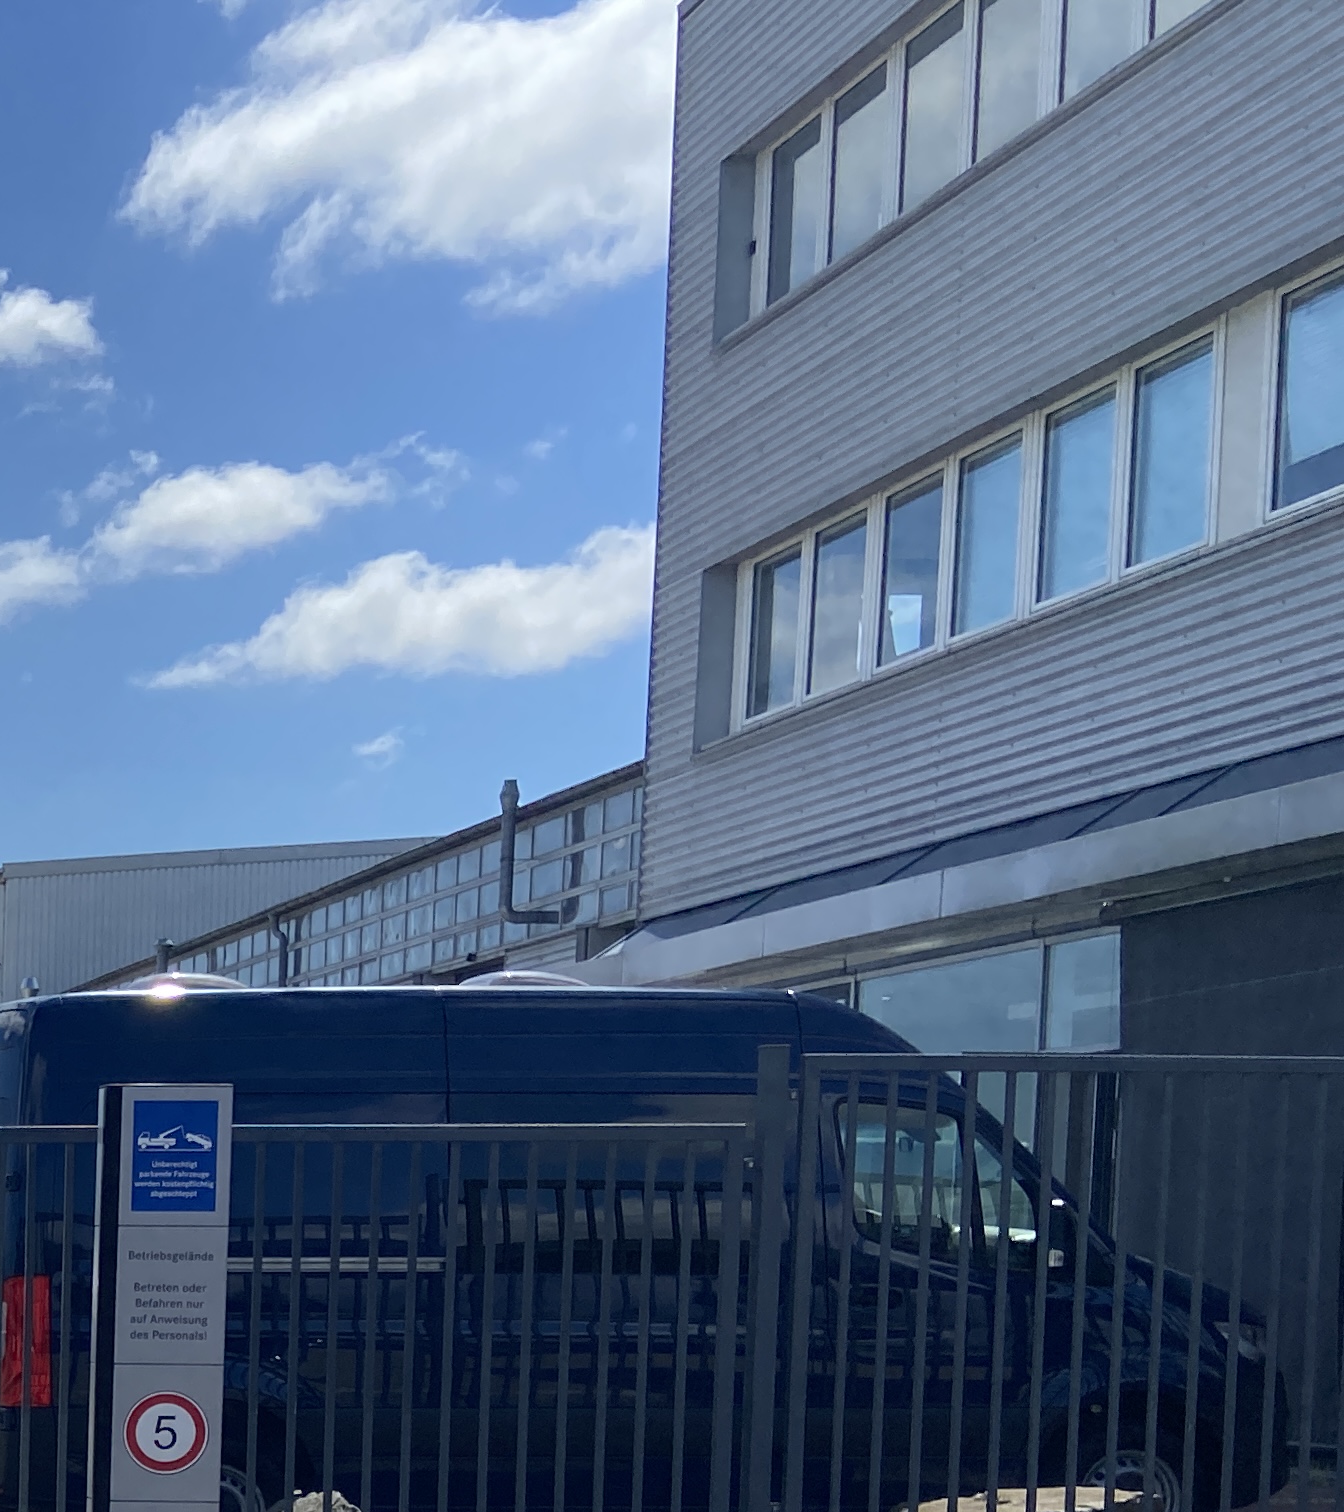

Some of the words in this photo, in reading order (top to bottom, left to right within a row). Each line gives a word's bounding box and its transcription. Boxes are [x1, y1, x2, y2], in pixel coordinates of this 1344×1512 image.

[173, 1171, 210, 1180] Fahrzeuge
[128, 1250, 214, 1263] Betriebsgelände
[133, 1282, 180, 1293] Betreten
[182, 1283, 208, 1293] oder
[135, 1298, 183, 1308] Befahren
[186, 1300, 205, 1309] nur
[130, 1314, 148, 1324] auf
[150, 1314, 208, 1327] Anweisung
[130, 1330, 149, 1340] des
[152, 1330, 208, 1341] Personals!
[154, 1415, 177, 1450] 5
